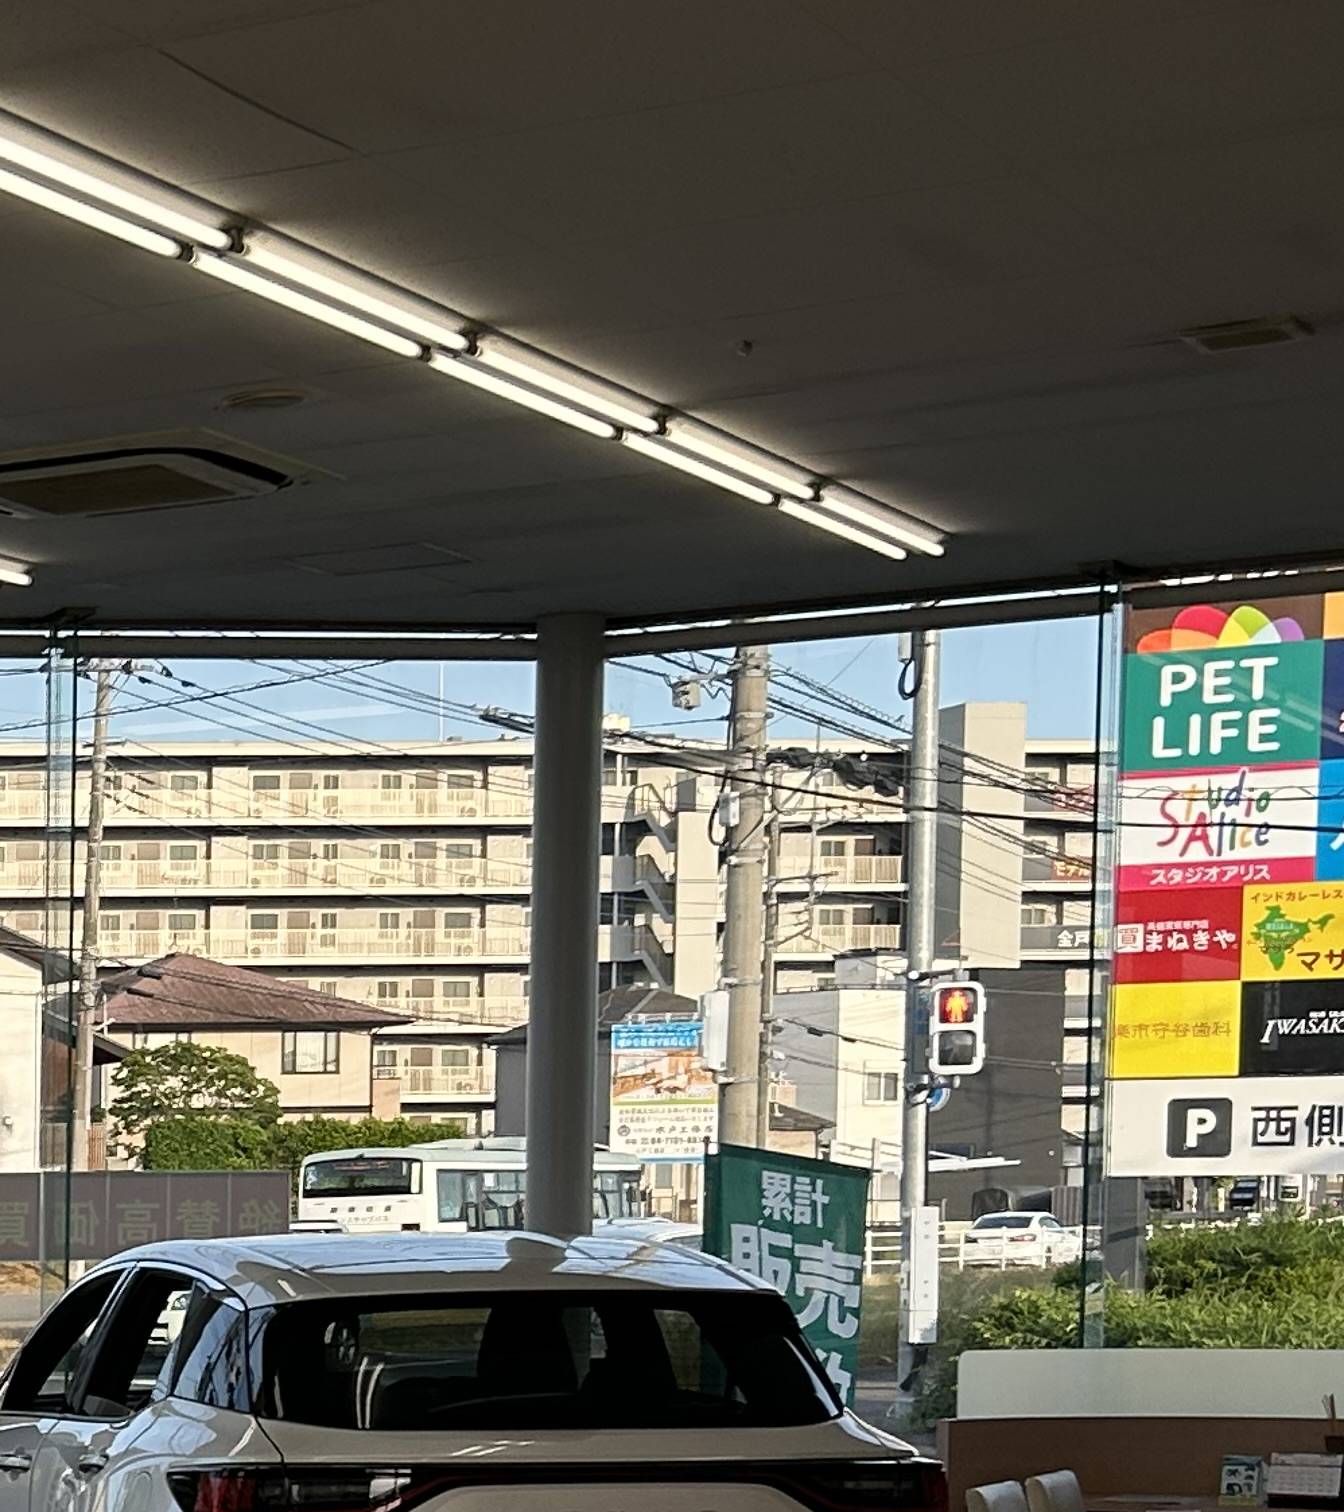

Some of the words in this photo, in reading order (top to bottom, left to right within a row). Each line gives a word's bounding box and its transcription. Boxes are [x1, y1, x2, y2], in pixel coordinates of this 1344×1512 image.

[1160, 656, 1279, 708] PET
[1152, 708, 1282, 759] LIFE
[1157, 770, 1272, 846] Studio
[1179, 812, 1270, 857] Alice
[1150, 864, 1271, 885] スタジオアリス
[1145, 929, 1236, 951] まねきや
[1184, 1108, 1217, 1149] P
[1250, 1104, 1344, 1148] 西側
[760, 1169, 830, 1229] 累計
[730, 1224, 864, 1340] 販売
